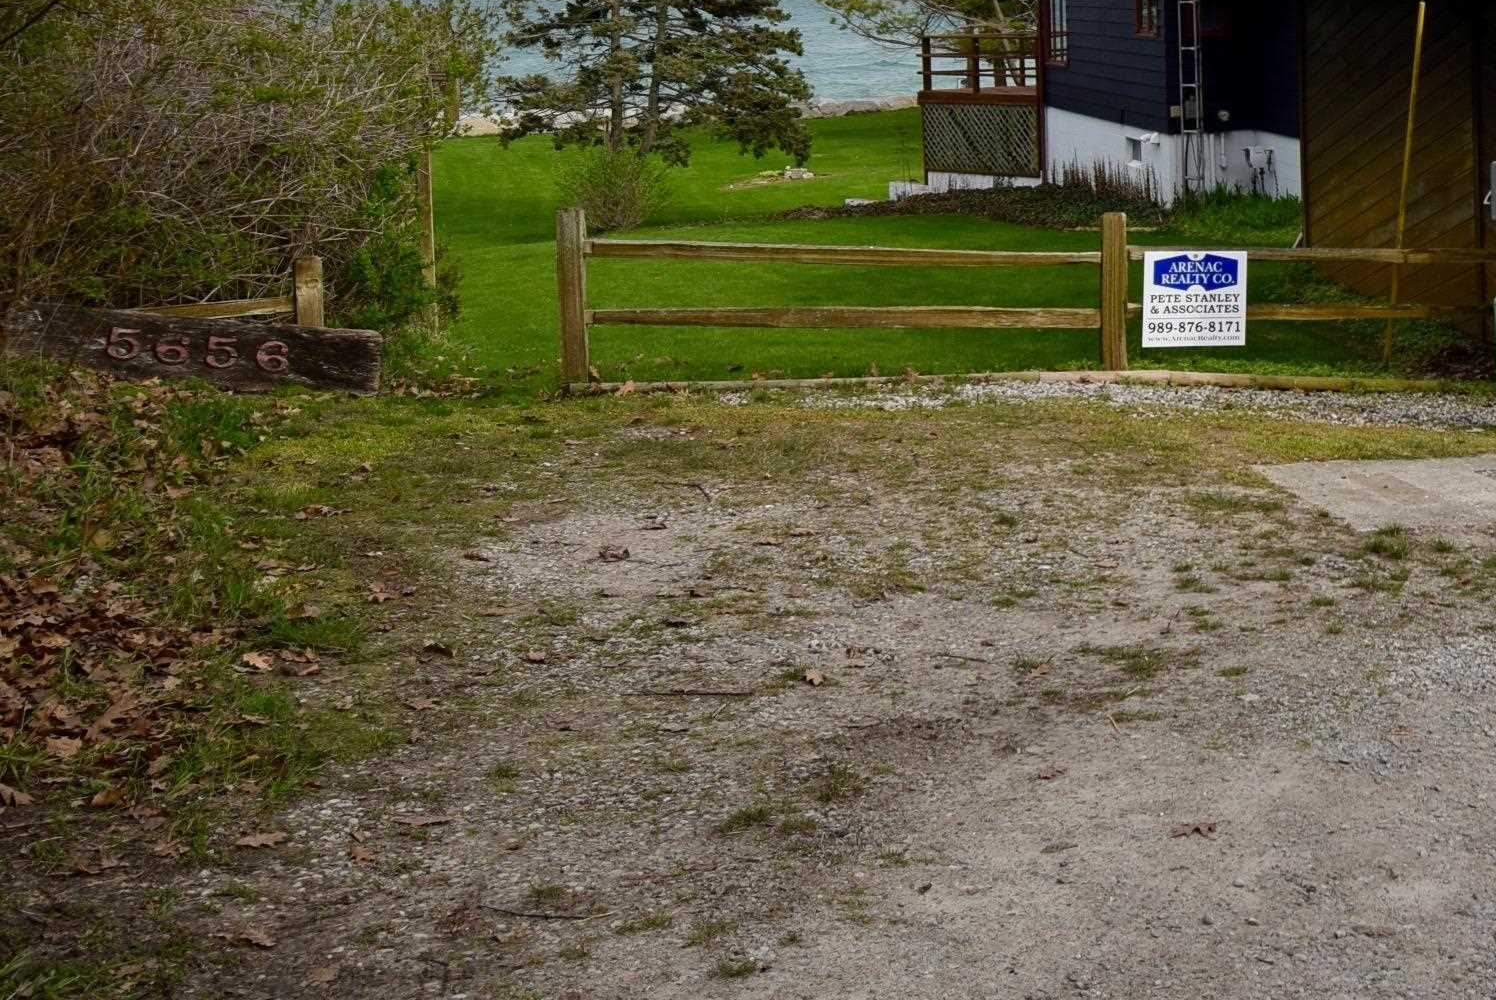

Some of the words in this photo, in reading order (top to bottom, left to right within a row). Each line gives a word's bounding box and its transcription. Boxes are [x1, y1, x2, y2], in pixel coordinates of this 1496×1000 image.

[1169, 262, 1223, 272] ARENAC
[1161, 274, 1210, 284] REALTY
[1213, 274, 1234, 283] CO.
[1150, 295, 1181, 303] PETE
[1186, 294, 1240, 302] STANLEY
[1151, 306, 1159, 314] &
[1164, 305, 1239, 314] ASSOCIATES
[1149, 321, 1240, 333] 989-876-8171
[106, 326, 289, 373] 5656
